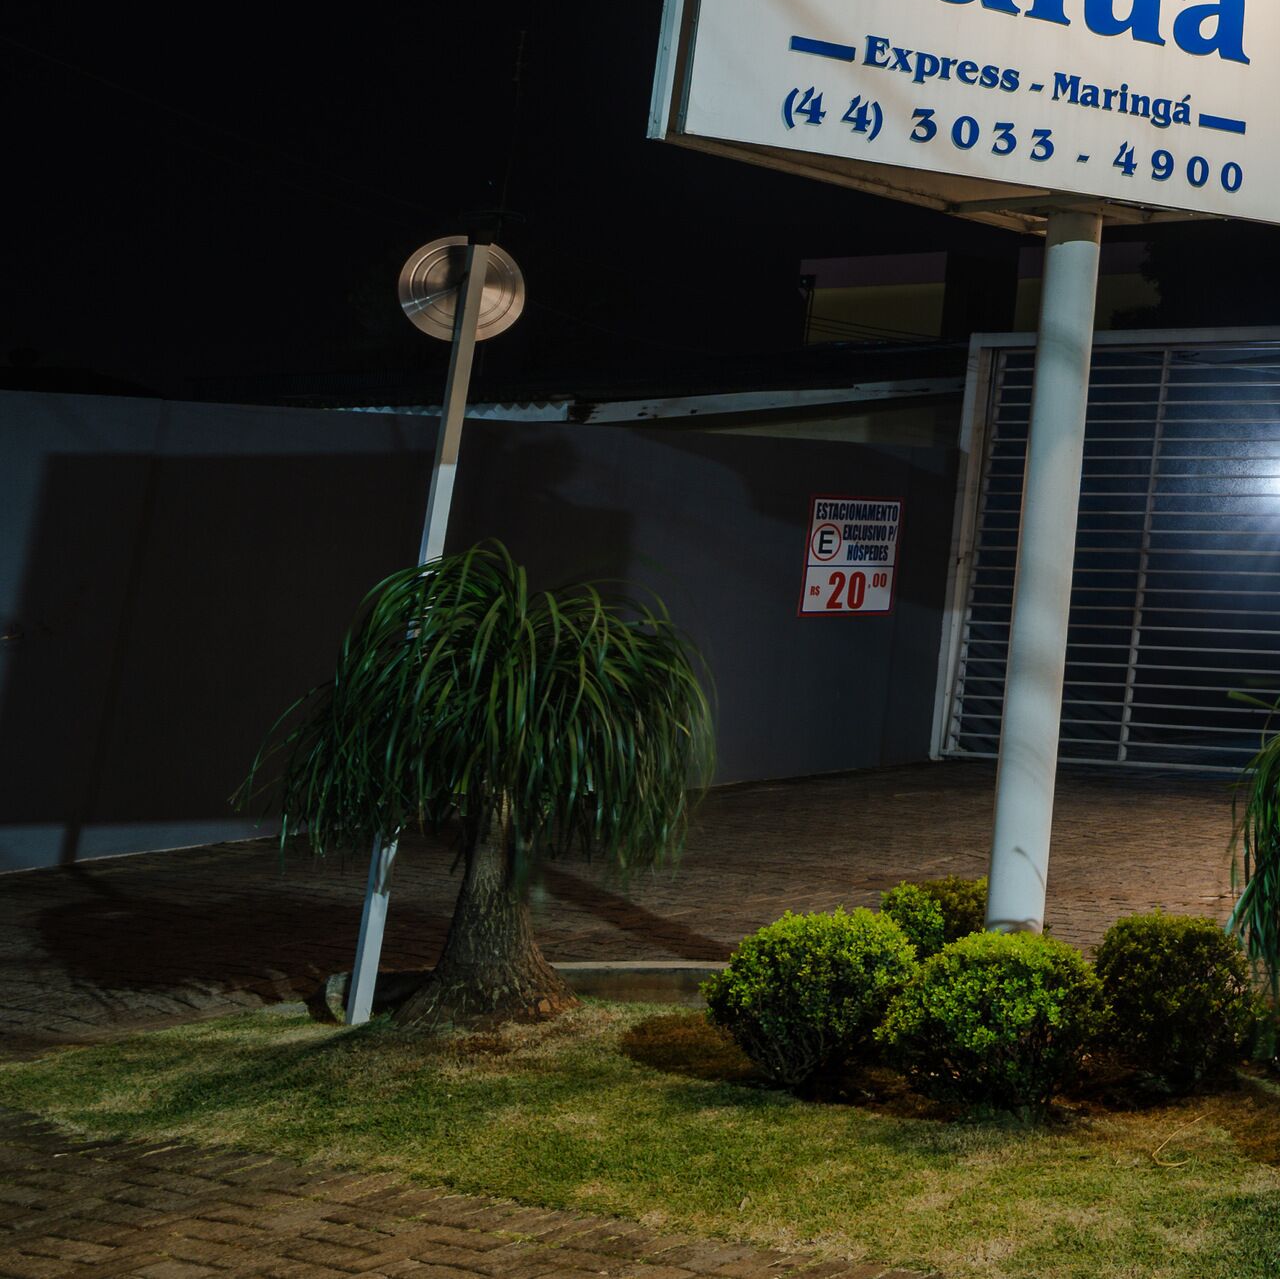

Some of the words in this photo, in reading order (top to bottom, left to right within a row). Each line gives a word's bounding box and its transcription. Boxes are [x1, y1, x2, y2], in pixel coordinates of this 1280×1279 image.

[862, 34, 1020, 92] Express
[1051, 71, 1192, 130] Maringá
[816, 503, 898, 521] ESTACIONAMENTO
[843, 524, 886, 540] EXCLUSIVO
[846, 542, 889, 561] HÓSPEDES
[809, 585, 820, 596] R$
